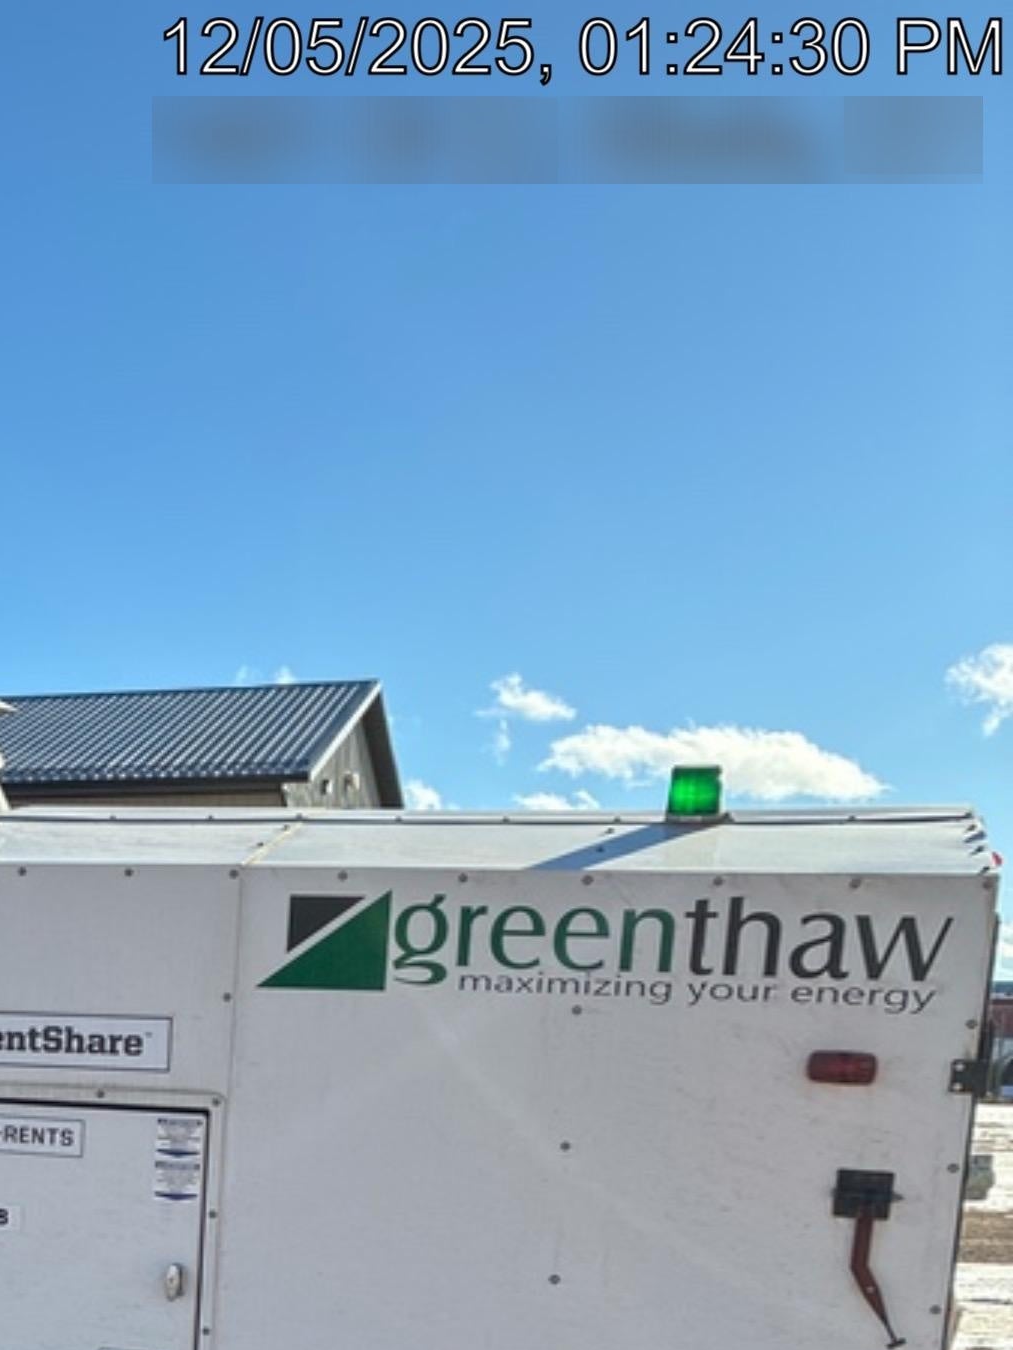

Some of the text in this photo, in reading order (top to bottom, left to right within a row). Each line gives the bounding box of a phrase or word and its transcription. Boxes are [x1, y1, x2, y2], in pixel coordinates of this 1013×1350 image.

[391, 894, 954, 987] greenthaw
[458, 970, 937, 1015] maximizing your energy
